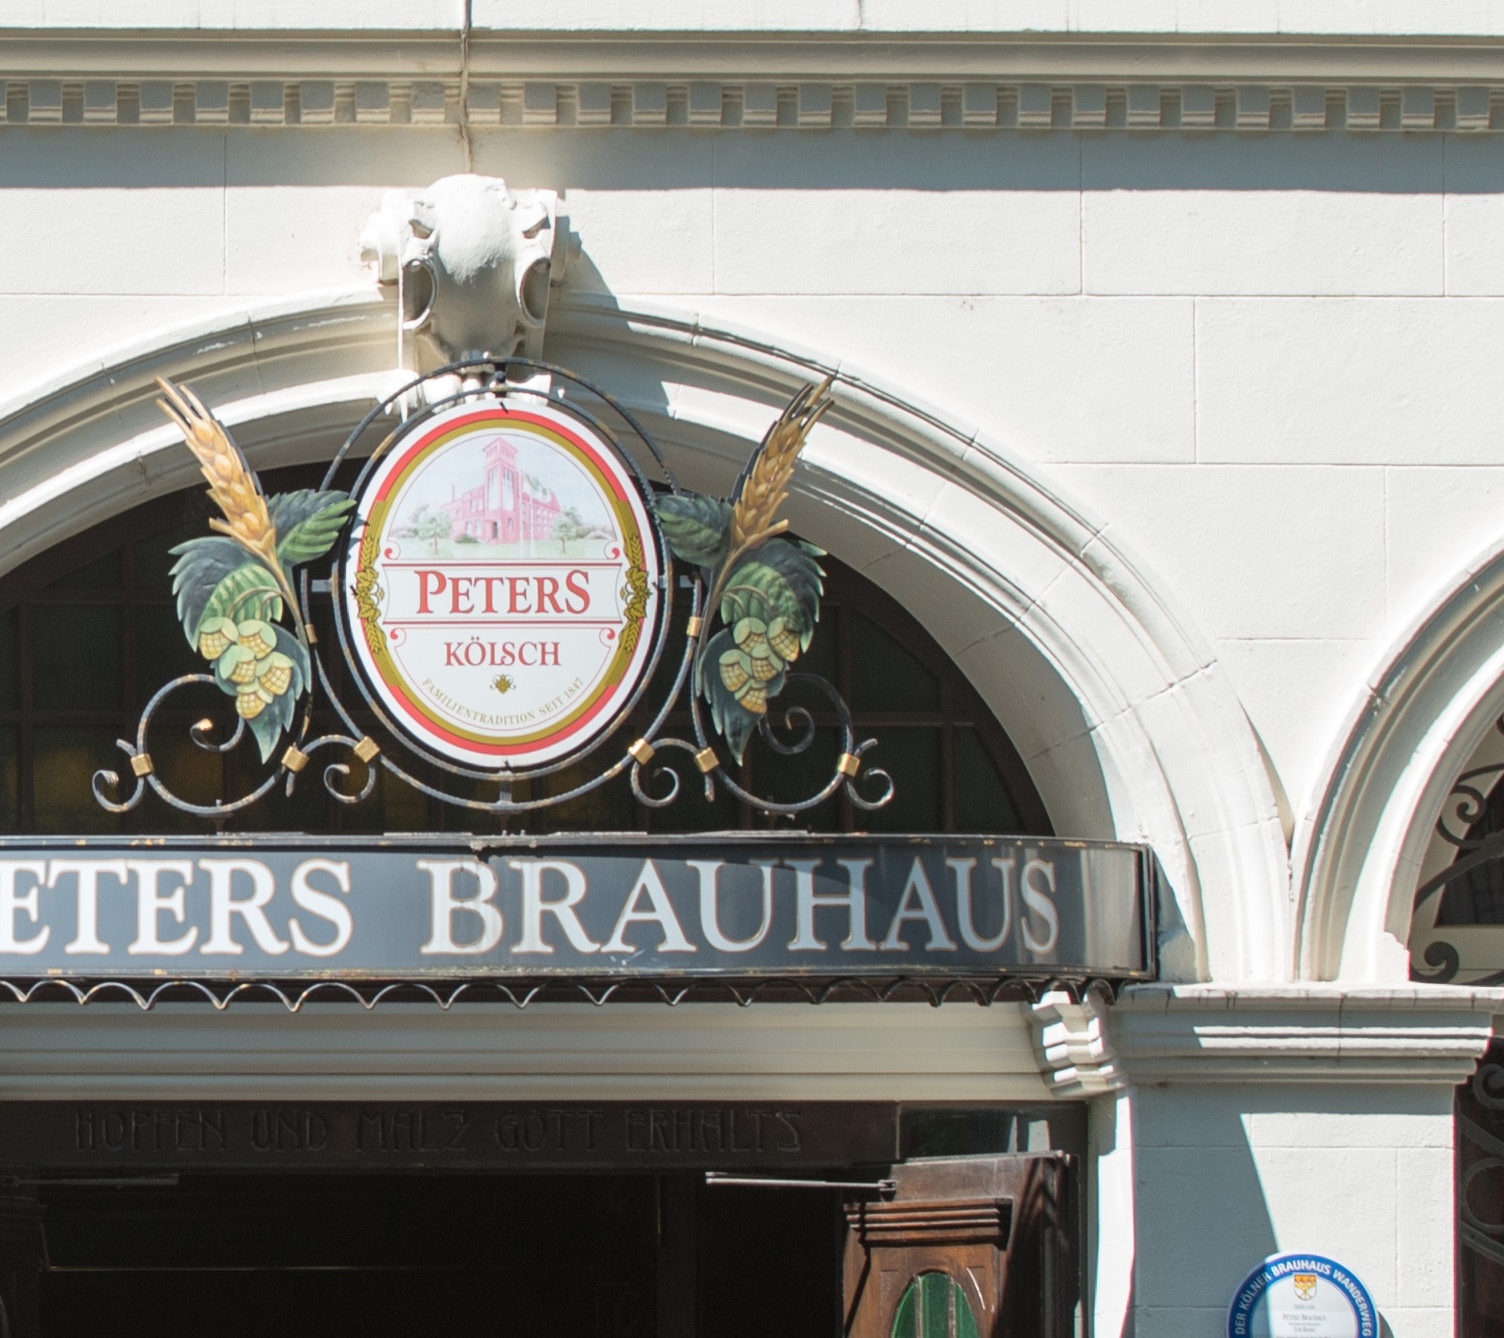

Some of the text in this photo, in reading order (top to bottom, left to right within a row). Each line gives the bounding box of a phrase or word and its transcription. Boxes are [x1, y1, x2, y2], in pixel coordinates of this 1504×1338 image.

[413, 569, 591, 614] PETERS
[443, 636, 562, 666] KÖLSCH
[421, 677, 536, 727] FAMILIENTRADITION
[538, 696, 565, 717] SEIT
[415, 857, 1060, 956] BRAUHAUS
[74, 1108, 226, 1152] HOPFEN
[249, 1108, 330, 1152] UND
[356, 1108, 467, 1153] MALZ
[493, 1108, 605, 1153] GOTT
[1234, 1259, 1373, 1338] DER KÖLNER BRAUHAUS WANDERWEG
